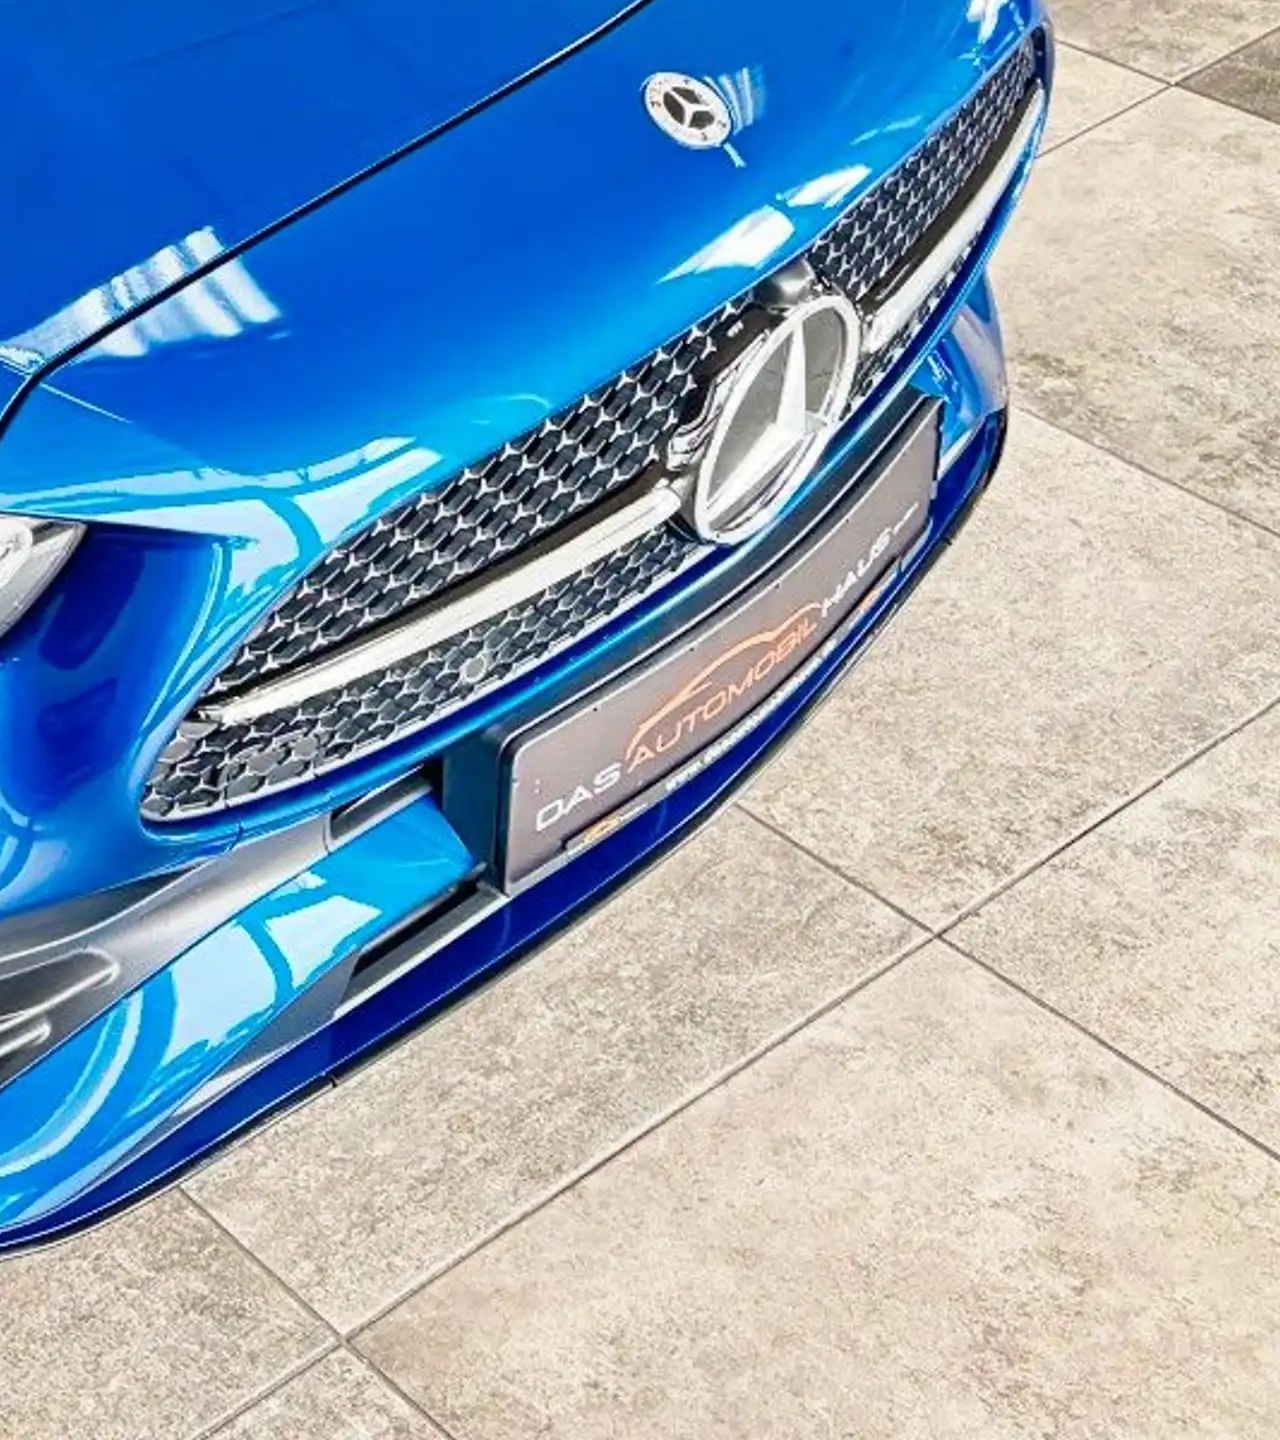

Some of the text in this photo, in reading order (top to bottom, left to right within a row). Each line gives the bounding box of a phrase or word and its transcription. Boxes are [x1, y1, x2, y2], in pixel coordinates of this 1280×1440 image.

[536, 762, 621, 832] DAS
[627, 617, 817, 774] AUTOMOBIL
[821, 527, 890, 618] HAUS
